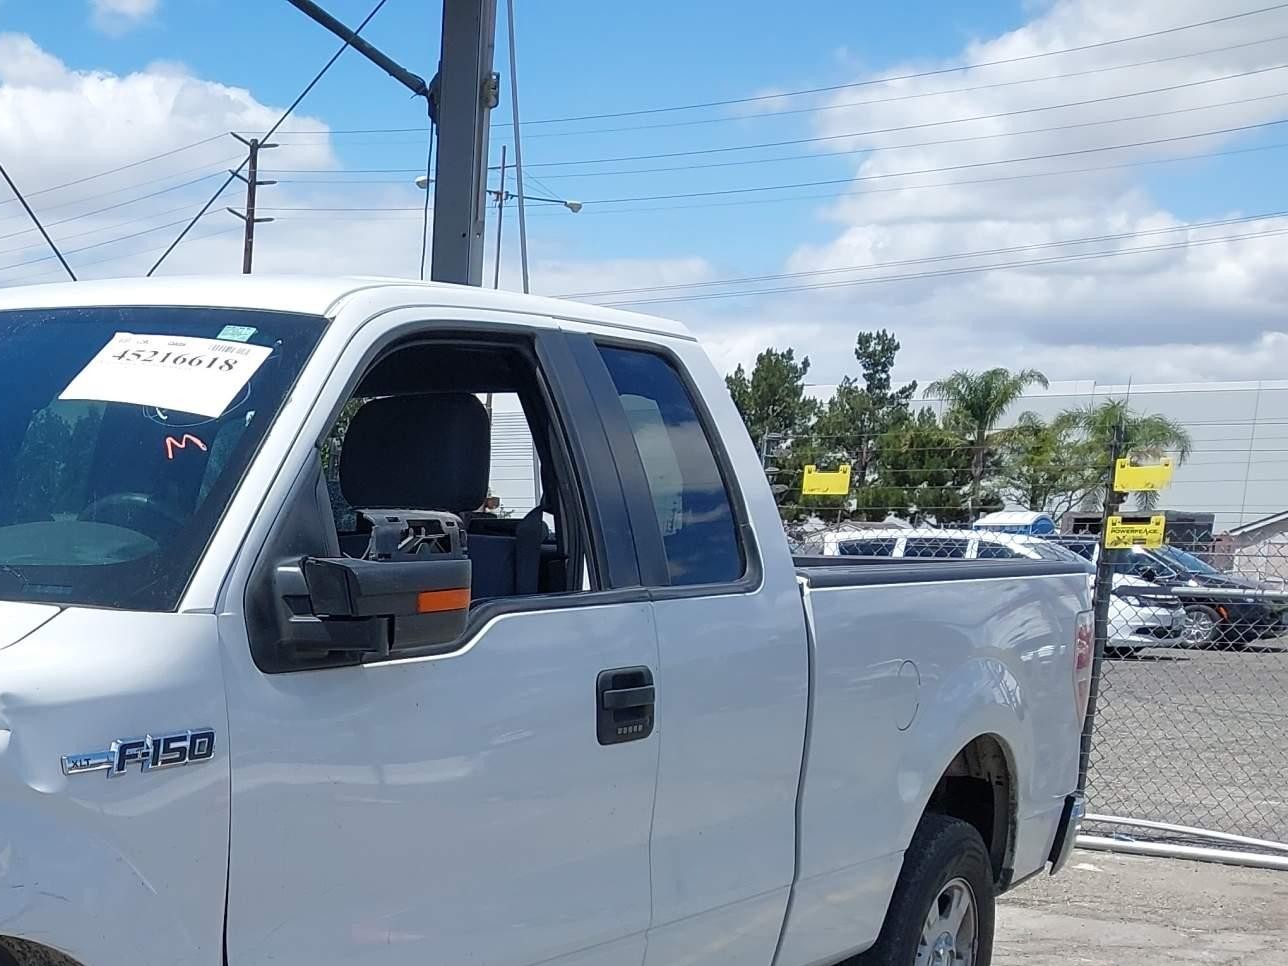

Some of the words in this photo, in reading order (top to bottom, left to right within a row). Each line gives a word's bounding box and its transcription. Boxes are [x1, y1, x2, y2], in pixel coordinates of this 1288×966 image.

[112, 349, 238, 371] 45216618
[71, 757, 92, 769] XLT
[114, 728, 216, 774] F-150
